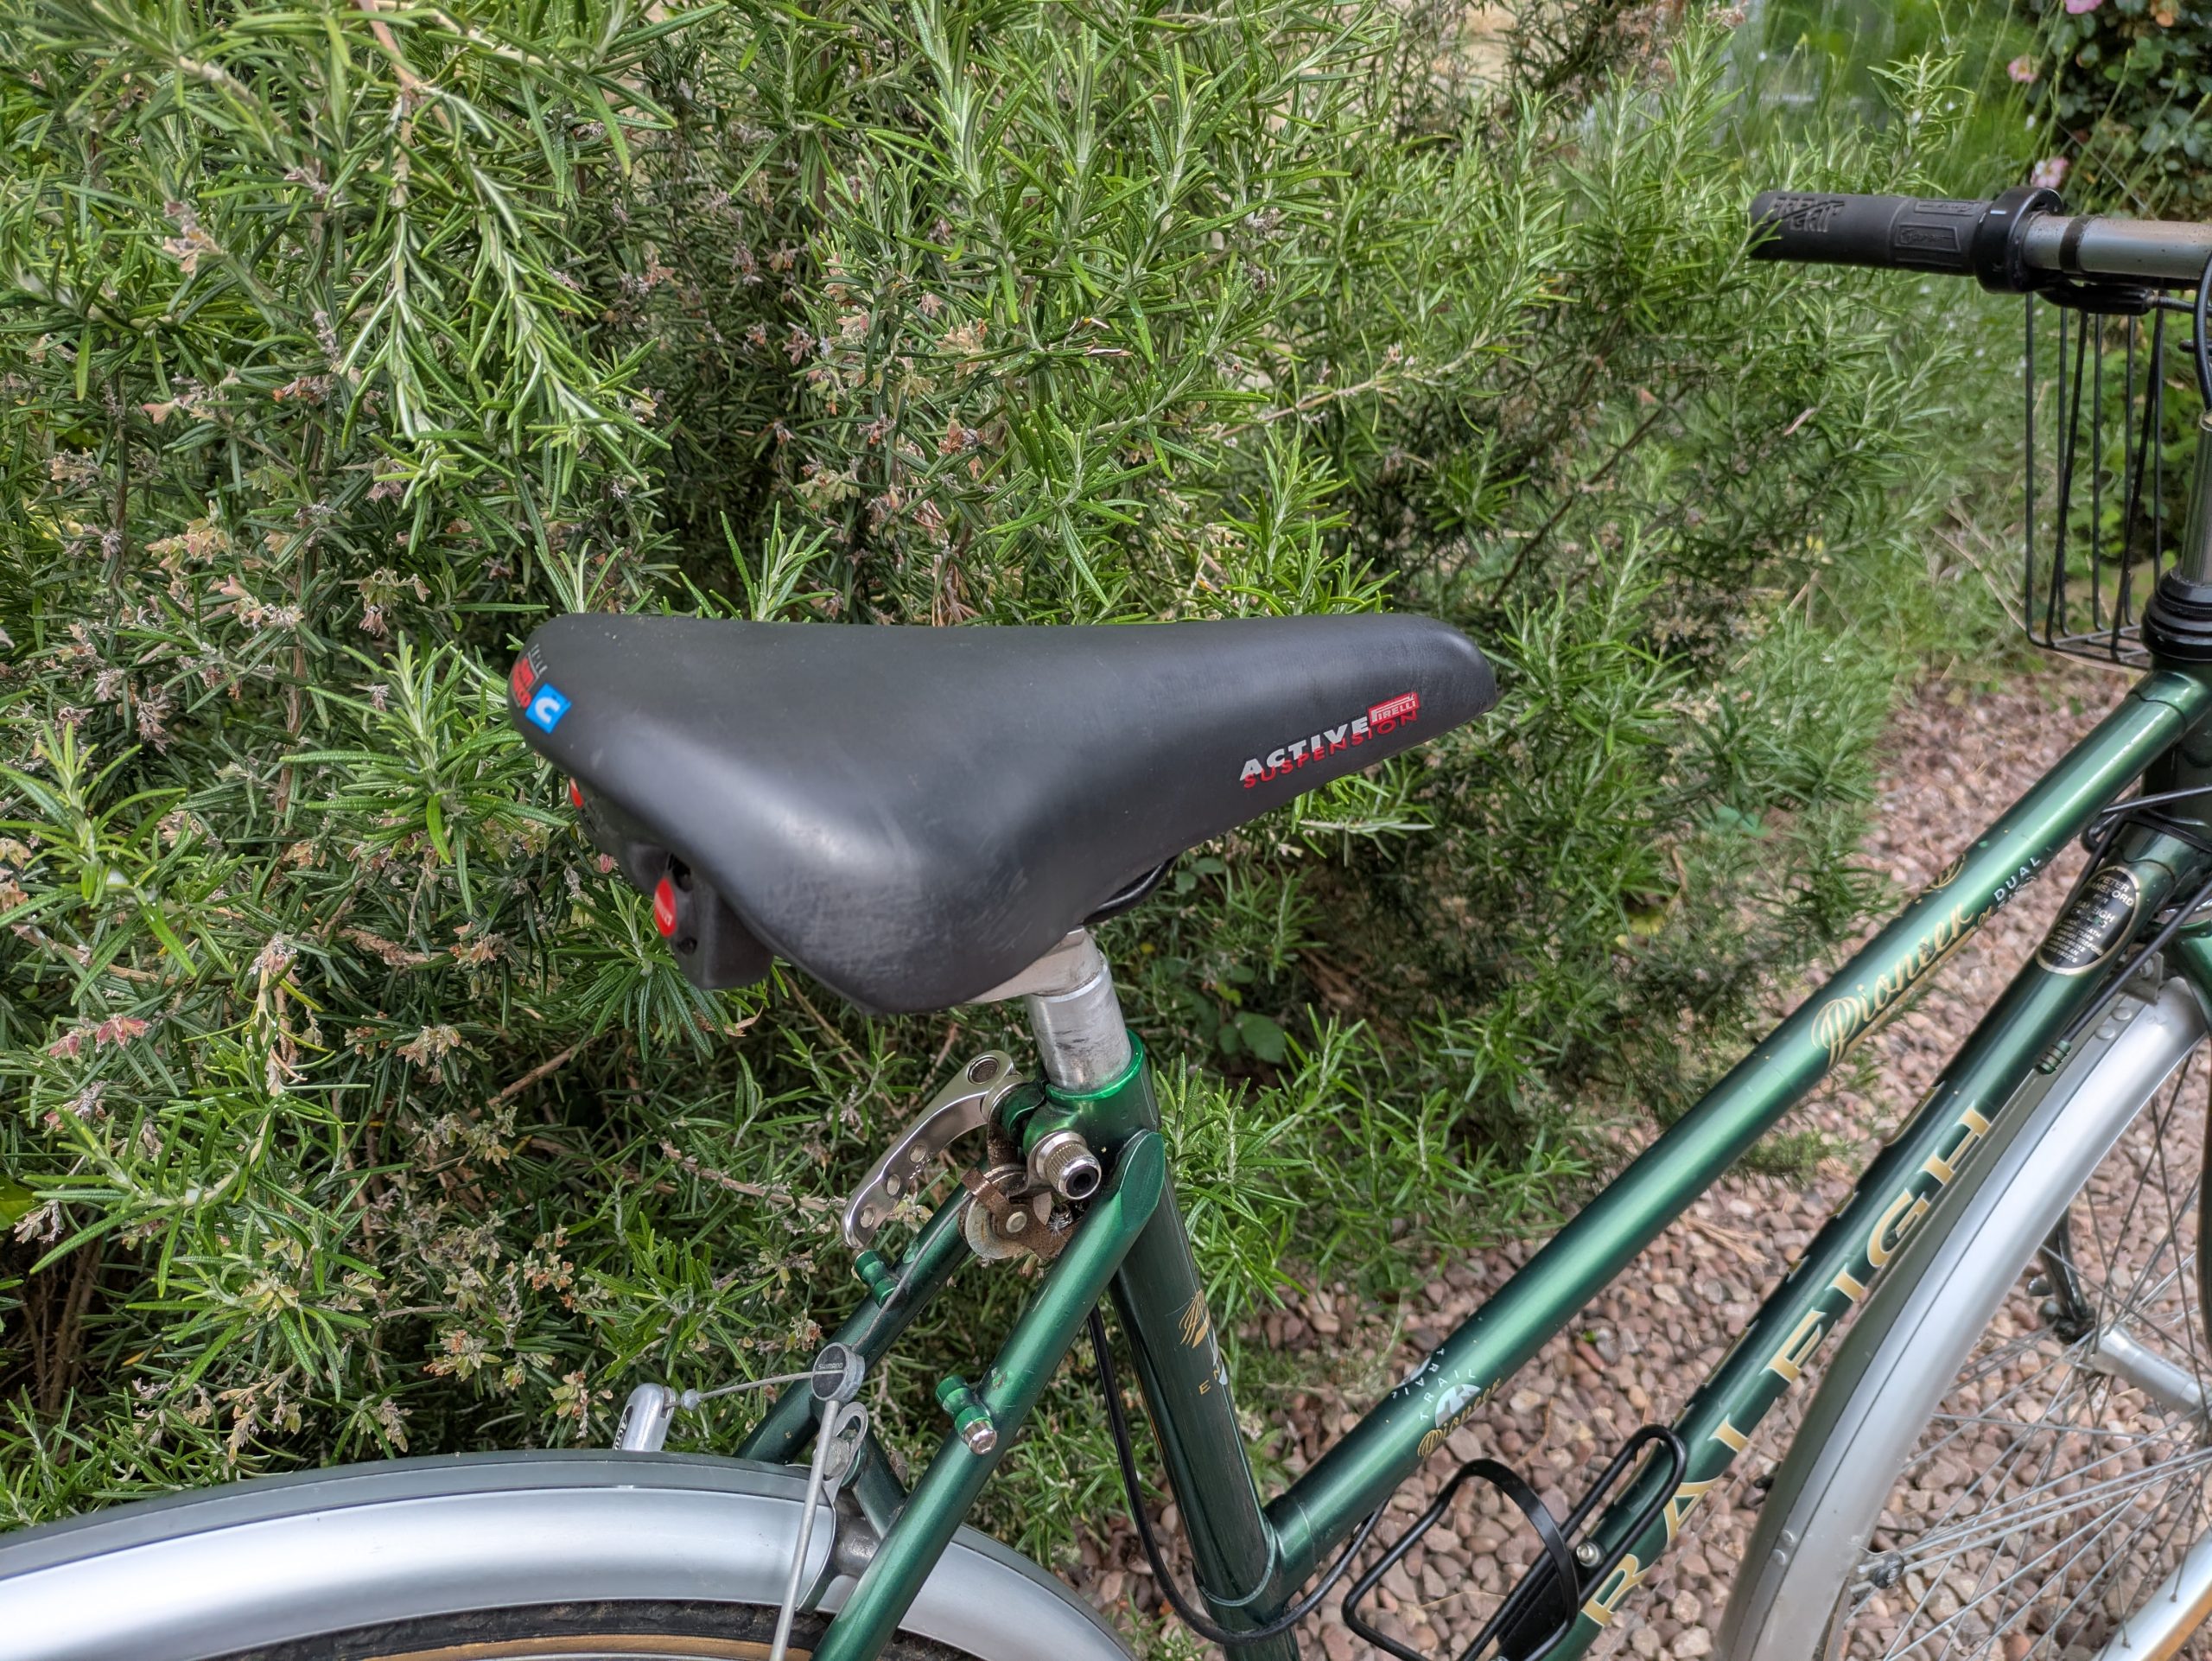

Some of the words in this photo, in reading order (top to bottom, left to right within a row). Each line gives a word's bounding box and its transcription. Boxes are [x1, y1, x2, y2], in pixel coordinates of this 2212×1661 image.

[1370, 695, 1416, 723] PIRELLI
[1239, 716, 1370, 781] ACTIVE
[1243, 709, 1419, 790] SUSPENSION
[1993, 856, 2041, 902] DUAL
[1811, 902, 1974, 1072] Pioneer
[1420, 1368, 1476, 1421] TRAIL
[1580, 1098, 1992, 1628] RALEIGH
